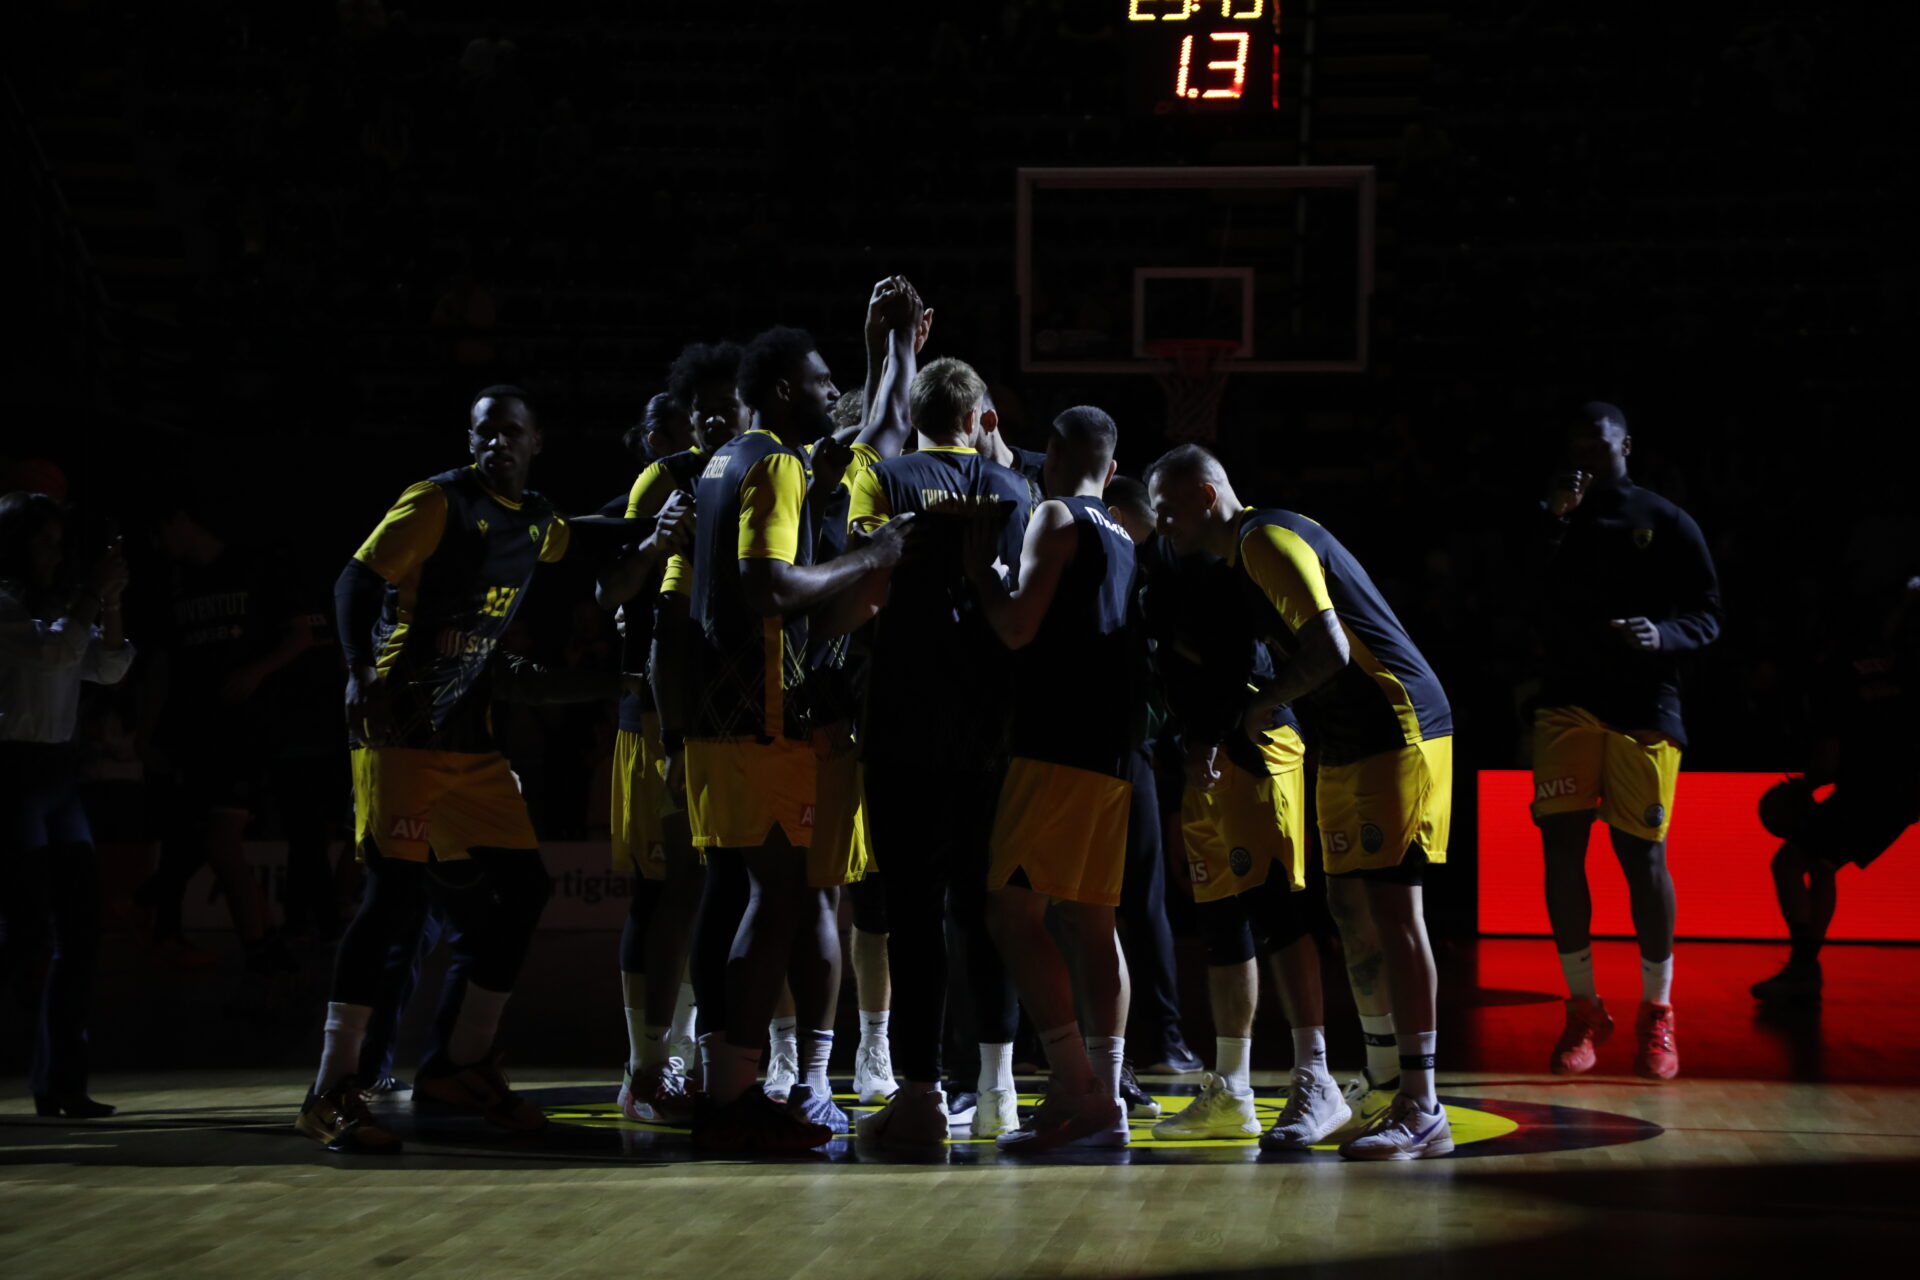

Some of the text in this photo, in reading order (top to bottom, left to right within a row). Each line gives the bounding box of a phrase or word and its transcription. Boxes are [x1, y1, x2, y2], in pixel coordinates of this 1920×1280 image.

[1175, 32, 1249, 99] 1.3
[1537, 777, 1577, 800] AVIS
[549, 868, 635, 903] rtigia
